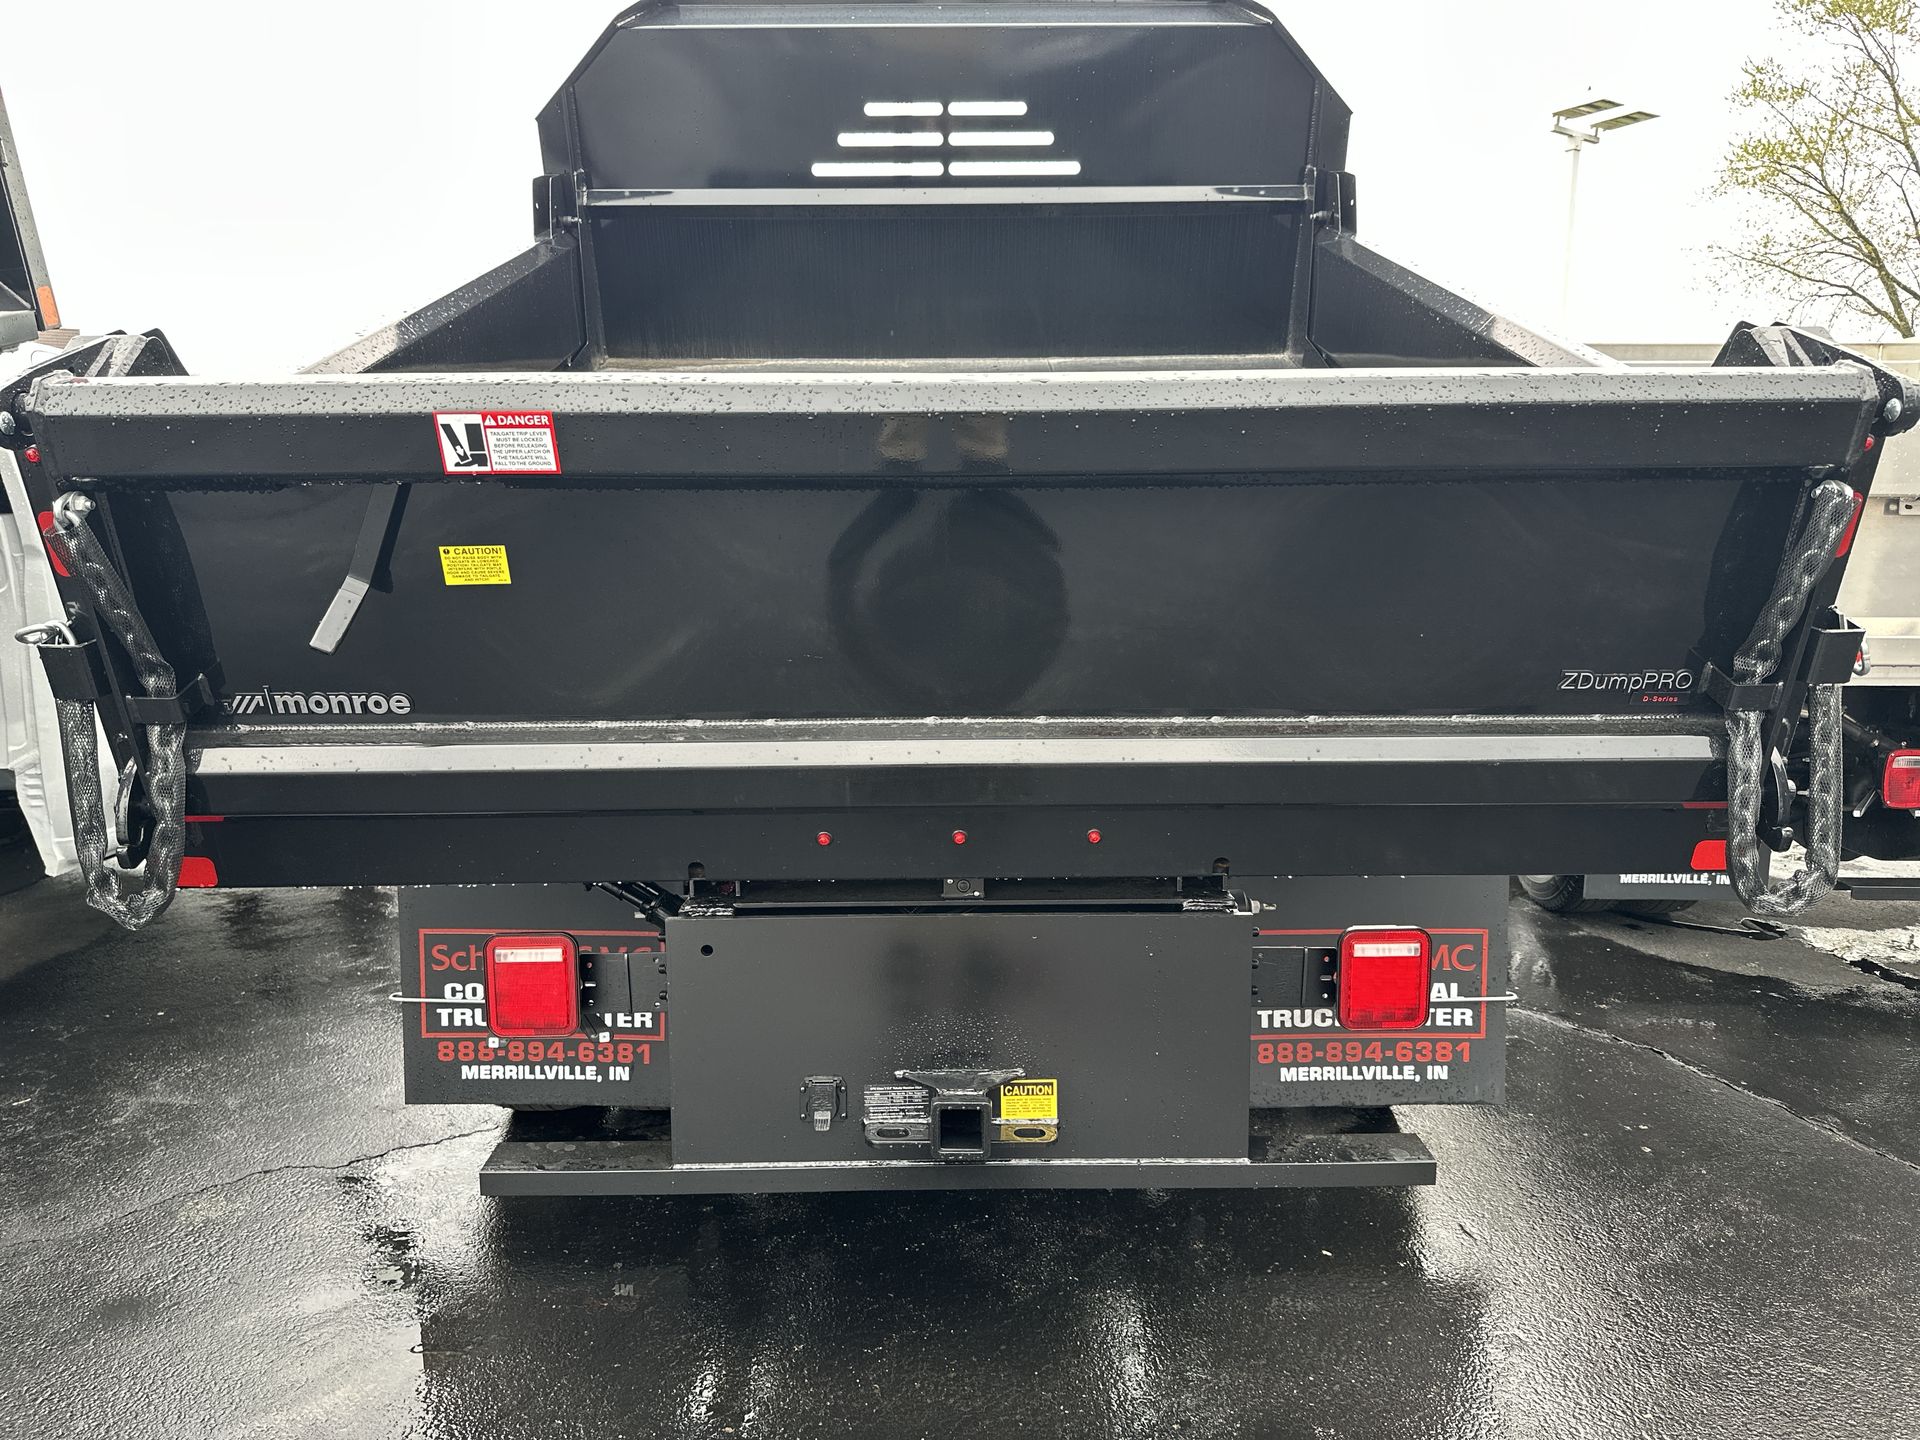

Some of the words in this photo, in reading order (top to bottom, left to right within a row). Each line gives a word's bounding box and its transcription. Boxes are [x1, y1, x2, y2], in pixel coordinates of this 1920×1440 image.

[497, 415, 550, 426] DANGER
[454, 547, 502, 555] CAUTION!
[1560, 672, 1693, 693] ZDumpPRO
[273, 693, 411, 715] monroe
[1618, 873, 1712, 886] MERRILLVILLE,
[1715, 873, 1731, 885] IN
[1256, 1008, 1341, 1028] TRUC
[437, 1041, 650, 1065] 888-894-6381
[1257, 1041, 1471, 1064] 888-894-6381
[461, 1065, 603, 1083] MERRILLVILLE,
[608, 1066, 630, 1081] IN
[1280, 1065, 1421, 1082] MERRILLVILLE,
[1426, 1065, 1449, 1081] IN
[1004, 1085, 1052, 1096] CAUTION
